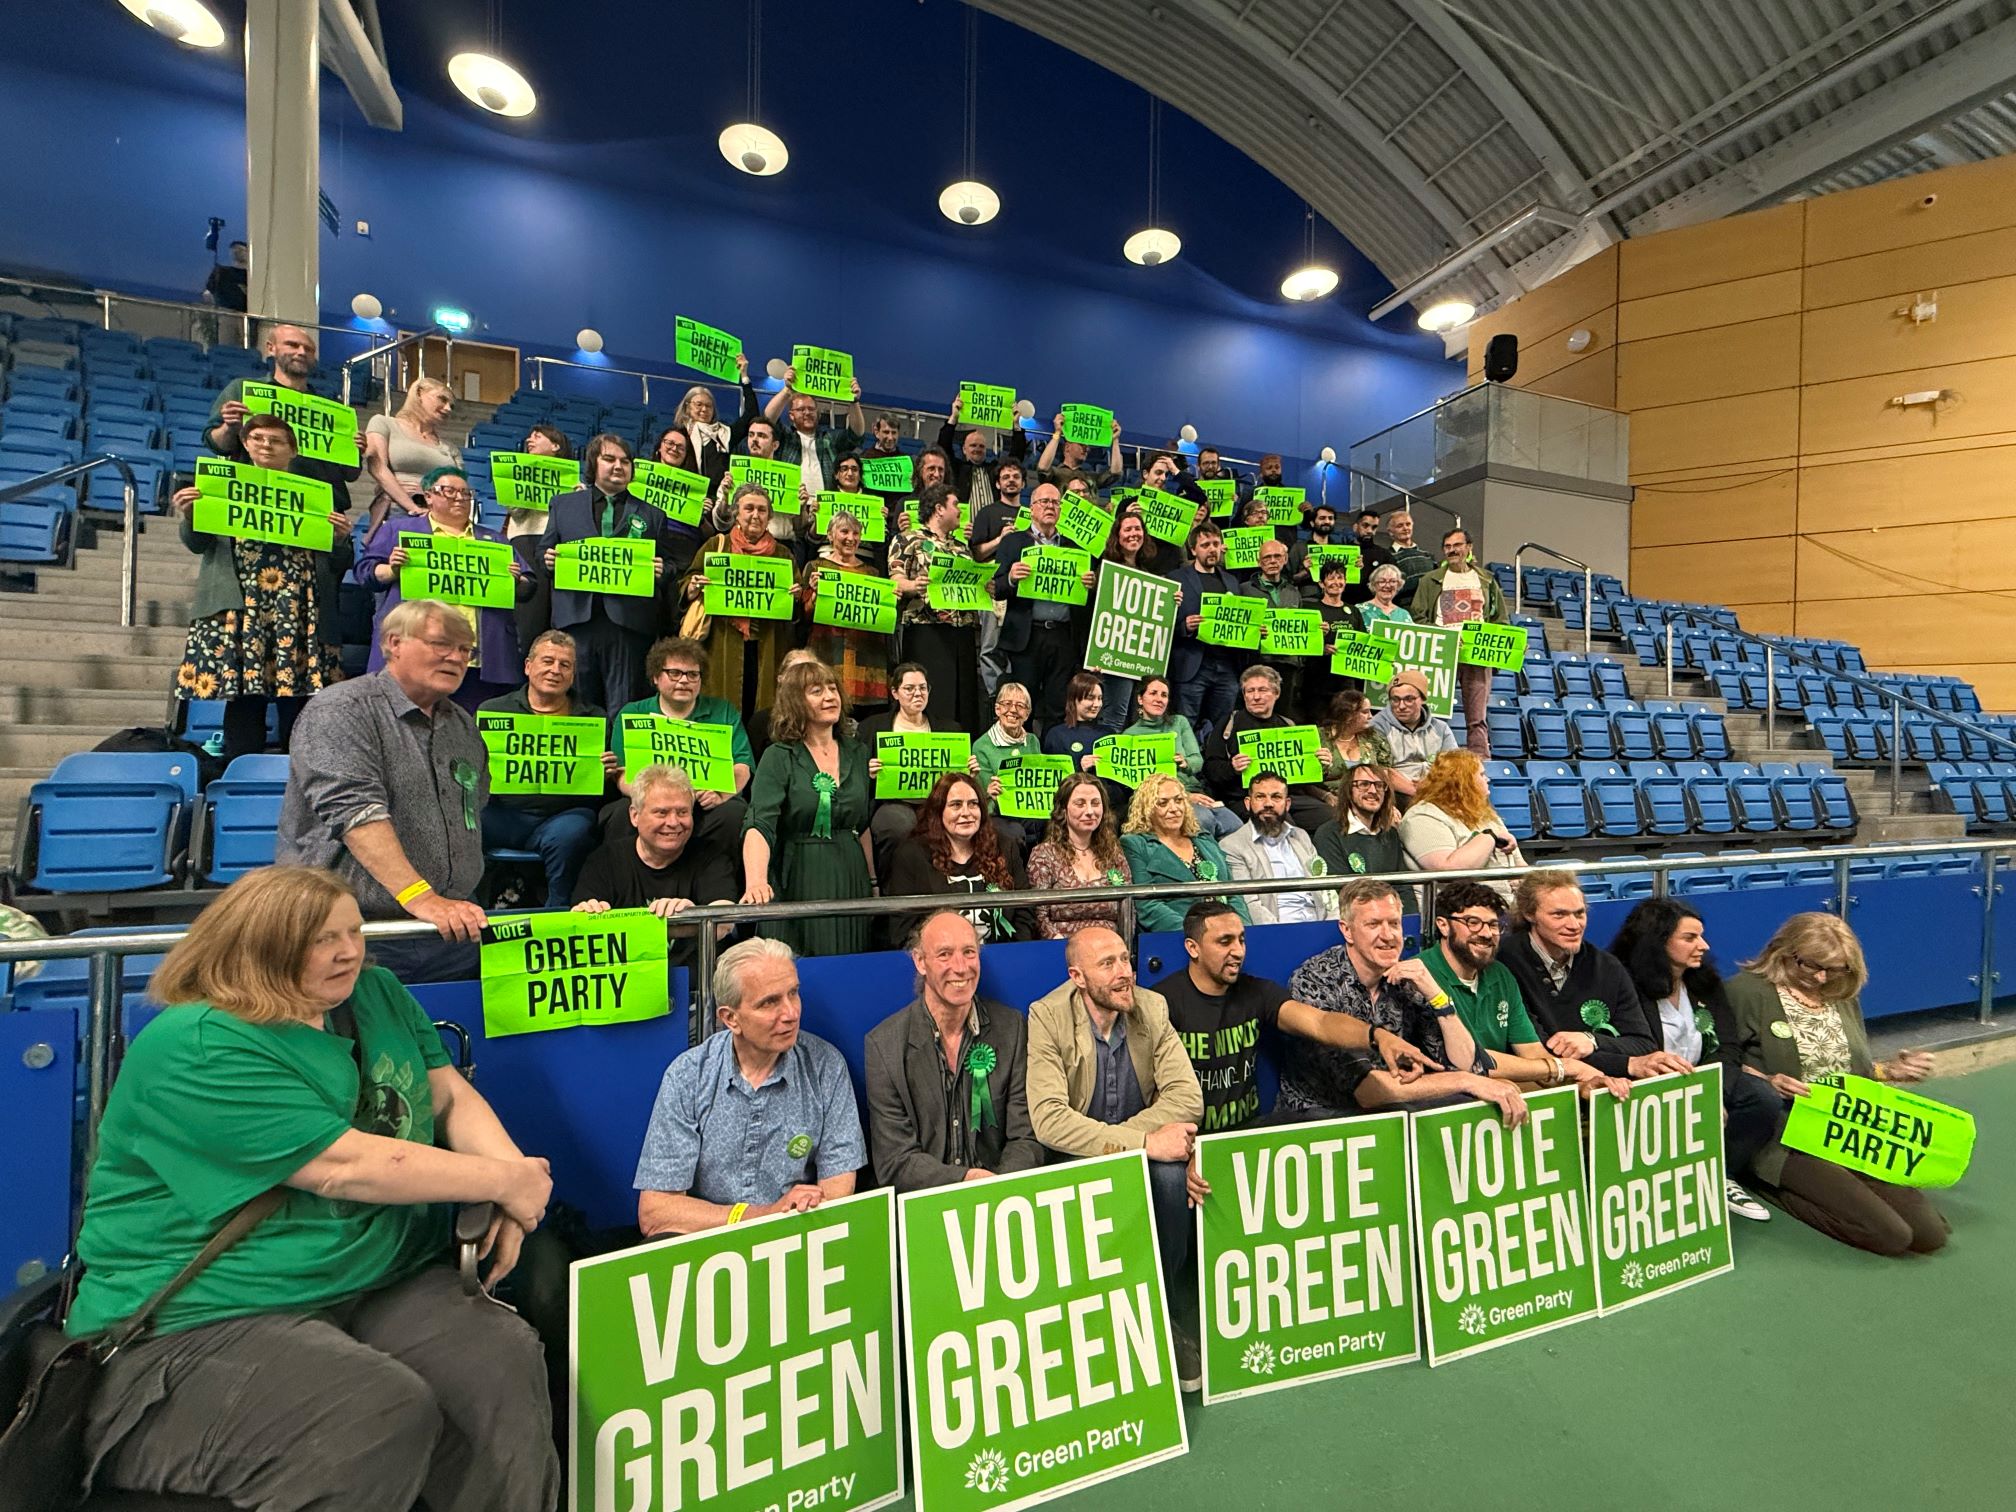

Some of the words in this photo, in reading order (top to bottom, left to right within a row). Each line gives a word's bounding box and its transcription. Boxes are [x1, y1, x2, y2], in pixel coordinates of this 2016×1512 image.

[691, 331, 729, 356] GREEN
[691, 347, 727, 373] PARTY
[805, 357, 842, 377] GREEN
[252, 388, 273, 398] VOTE
[805, 374, 840, 394] PARTY
[972, 392, 1003, 408] GREEN
[270, 401, 334, 433] GREEN
[971, 406, 1002, 422] PARTY
[1072, 411, 1103, 427] GREEN
[298, 431, 334, 453] RTY
[1071, 425, 1102, 440] PARTY
[207, 466, 231, 477] VOTE
[735, 459, 749, 467] VOTE
[869, 462, 903, 473] GREEN
[513, 464, 560, 487] GREEN
[646, 472, 691, 499] GREEN
[745, 468, 786, 489] GREEN
[871, 473, 903, 488] PARTY
[228, 480, 305, 513] GREEN
[644, 487, 686, 515] PARTY
[1265, 495, 1294, 508] GREEN
[228, 504, 304, 537] PARTY
[1068, 506, 1103, 533] GREEN
[1149, 500, 1183, 523] GREEN
[1268, 509, 1292, 521] ARTY
[1145, 514, 1178, 538] PARTY
[409, 539, 429, 548] VOTE
[1234, 535, 1264, 550] GREEN
[427, 551, 490, 575] GREEN
[578, 545, 633, 566] GREEN
[711, 557, 727, 565] VOTE
[937, 558, 951, 567] VOTE
[1236, 550, 1260, 563] PART
[578, 564, 633, 586] PARTY
[824, 572, 839, 580] VOTE
[942, 569, 982, 585] GREEN
[1037, 556, 1078, 578] GREEN
[428, 573, 490, 598] PARTY
[724, 568, 776, 589] GREEN
[1034, 575, 1075, 597] PARTY
[725, 589, 775, 611] PARTY
[836, 582, 880, 606] GREEN
[941, 585, 977, 603] PARTY
[1112, 572, 1168, 622] VOTE
[833, 601, 880, 625] PARTY
[1214, 606, 1252, 624] GREEN
[1094, 611, 1169, 662] GREEN
[1212, 623, 1248, 641] PARTY
[1271, 619, 1309, 634] GREEN
[1273, 635, 1308, 649] PARTY
[1346, 641, 1384, 661] GREEN
[1474, 633, 1516, 650] GREEN
[1114, 658, 1135, 670] Green
[1135, 661, 1155, 674] Party
[1344, 657, 1380, 676] PARTY
[1471, 647, 1512, 664] PARTY
[487, 719, 510, 729] VOTE
[632, 719, 653, 728] VOTE
[505, 732, 577, 758] GREEN
[651, 731, 712, 758] GREEN
[884, 737, 902, 746] VOTE
[1099, 738, 1115, 747] VOTE
[1244, 733, 1259, 742] VOTE
[899, 748, 951, 768] GREEN
[1110, 747, 1156, 766] GREEN
[1256, 739, 1304, 761] GREEN
[505, 759, 577, 785] PARTY
[1005, 758, 1019, 768] VOTE
[898, 770, 950, 791] PART
[1014, 768, 1063, 788] GREEN
[1015, 790, 1055, 811] PART
[492, 923, 526, 939] VOTE
[524, 931, 628, 975] GREEN
[527, 971, 628, 1018] PARTY
[1178, 1031, 1210, 1060] HE
[1214, 1017, 1260, 1059] WINDS
[1613, 1083, 1706, 1175] VOTE
[1831, 1091, 1933, 1148] GREEN
[1440, 1107, 1561, 1205] VOTE
[1823, 1120, 1927, 1177] PARTY
[1231, 1133, 1380, 1237] VOTE
[1601, 1156, 1722, 1261] GREEN
[942, 1176, 1125, 1313] VOTE
[1430, 1190, 1586, 1304] GREEN
[1645, 1255, 1681, 1281] Green
[1682, 1246, 1713, 1270] Party
[1214, 1224, 1405, 1340] GREEN
[628, 1221, 853, 1388] VOTE
[1489, 1297, 1534, 1327] Green
[1535, 1287, 1574, 1316] Party
[1280, 1336, 1337, 1368] Green
[1338, 1329, 1387, 1358] Party
[925, 1282, 1164, 1451] GREEN
[593, 1329, 884, 1512] GREEN
[1013, 1440, 1084, 1479] Green
[1086, 1418, 1146, 1457] Party
[787, 1471, 857, 1512] Party
